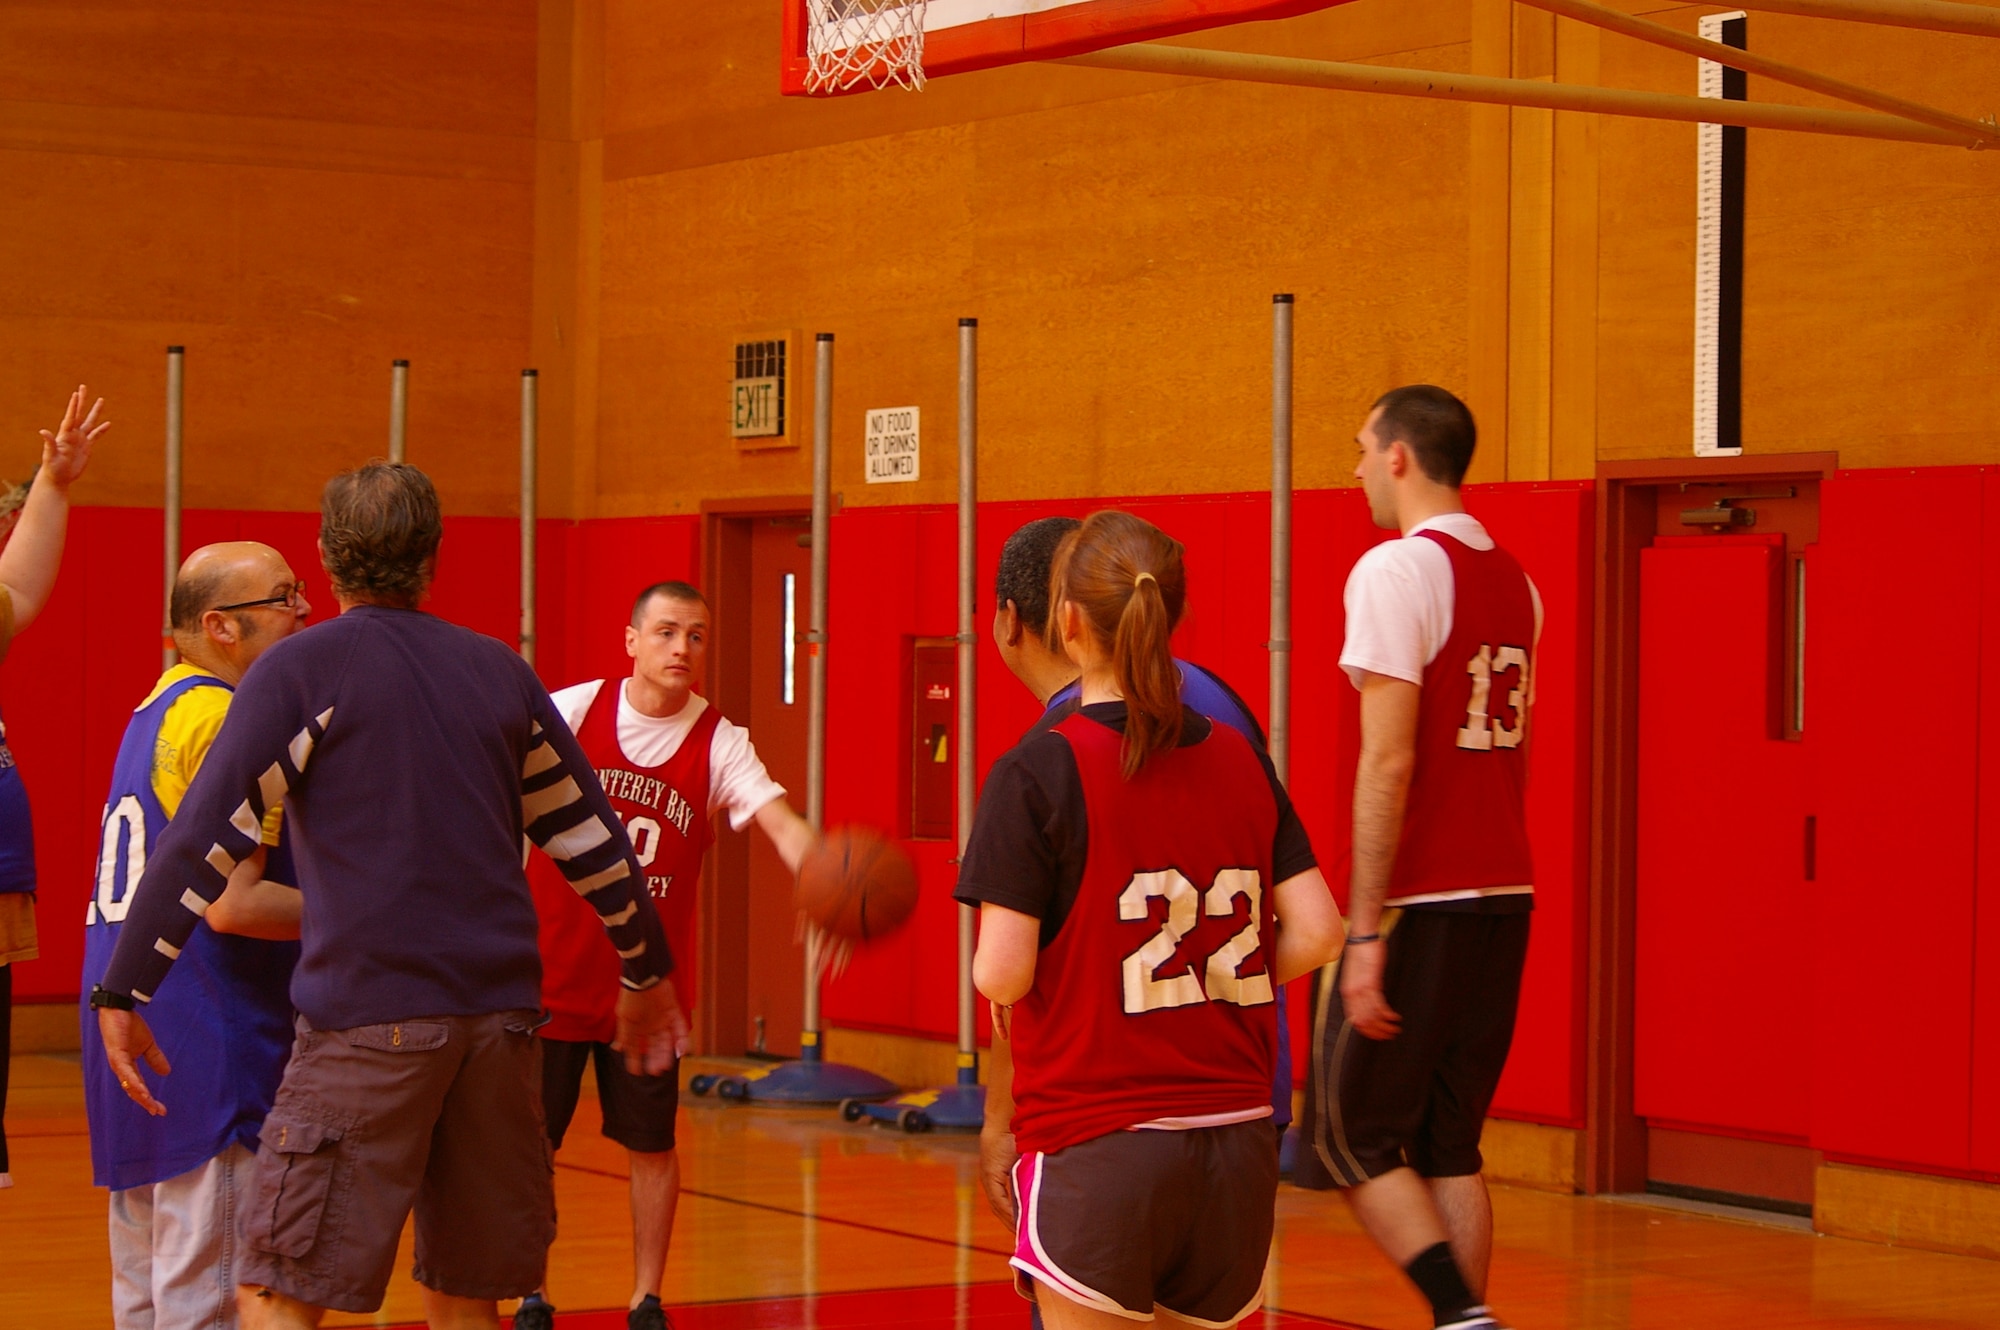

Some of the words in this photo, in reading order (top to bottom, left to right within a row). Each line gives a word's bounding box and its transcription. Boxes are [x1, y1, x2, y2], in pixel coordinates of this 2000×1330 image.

[735, 383, 772, 429] EXIT
[871, 415, 884, 434] NO
[887, 412, 912, 432] FOOD
[868, 437, 880, 456] OR
[884, 433, 917, 455] DRINKS
[870, 456, 914, 477] ALLOWED
[1455, 644, 1529, 751] 13
[593, 768, 667, 810] NTEREY
[663, 788, 695, 837] BAY
[614, 810, 662, 868] 0
[1118, 868, 1275, 1014] 22
